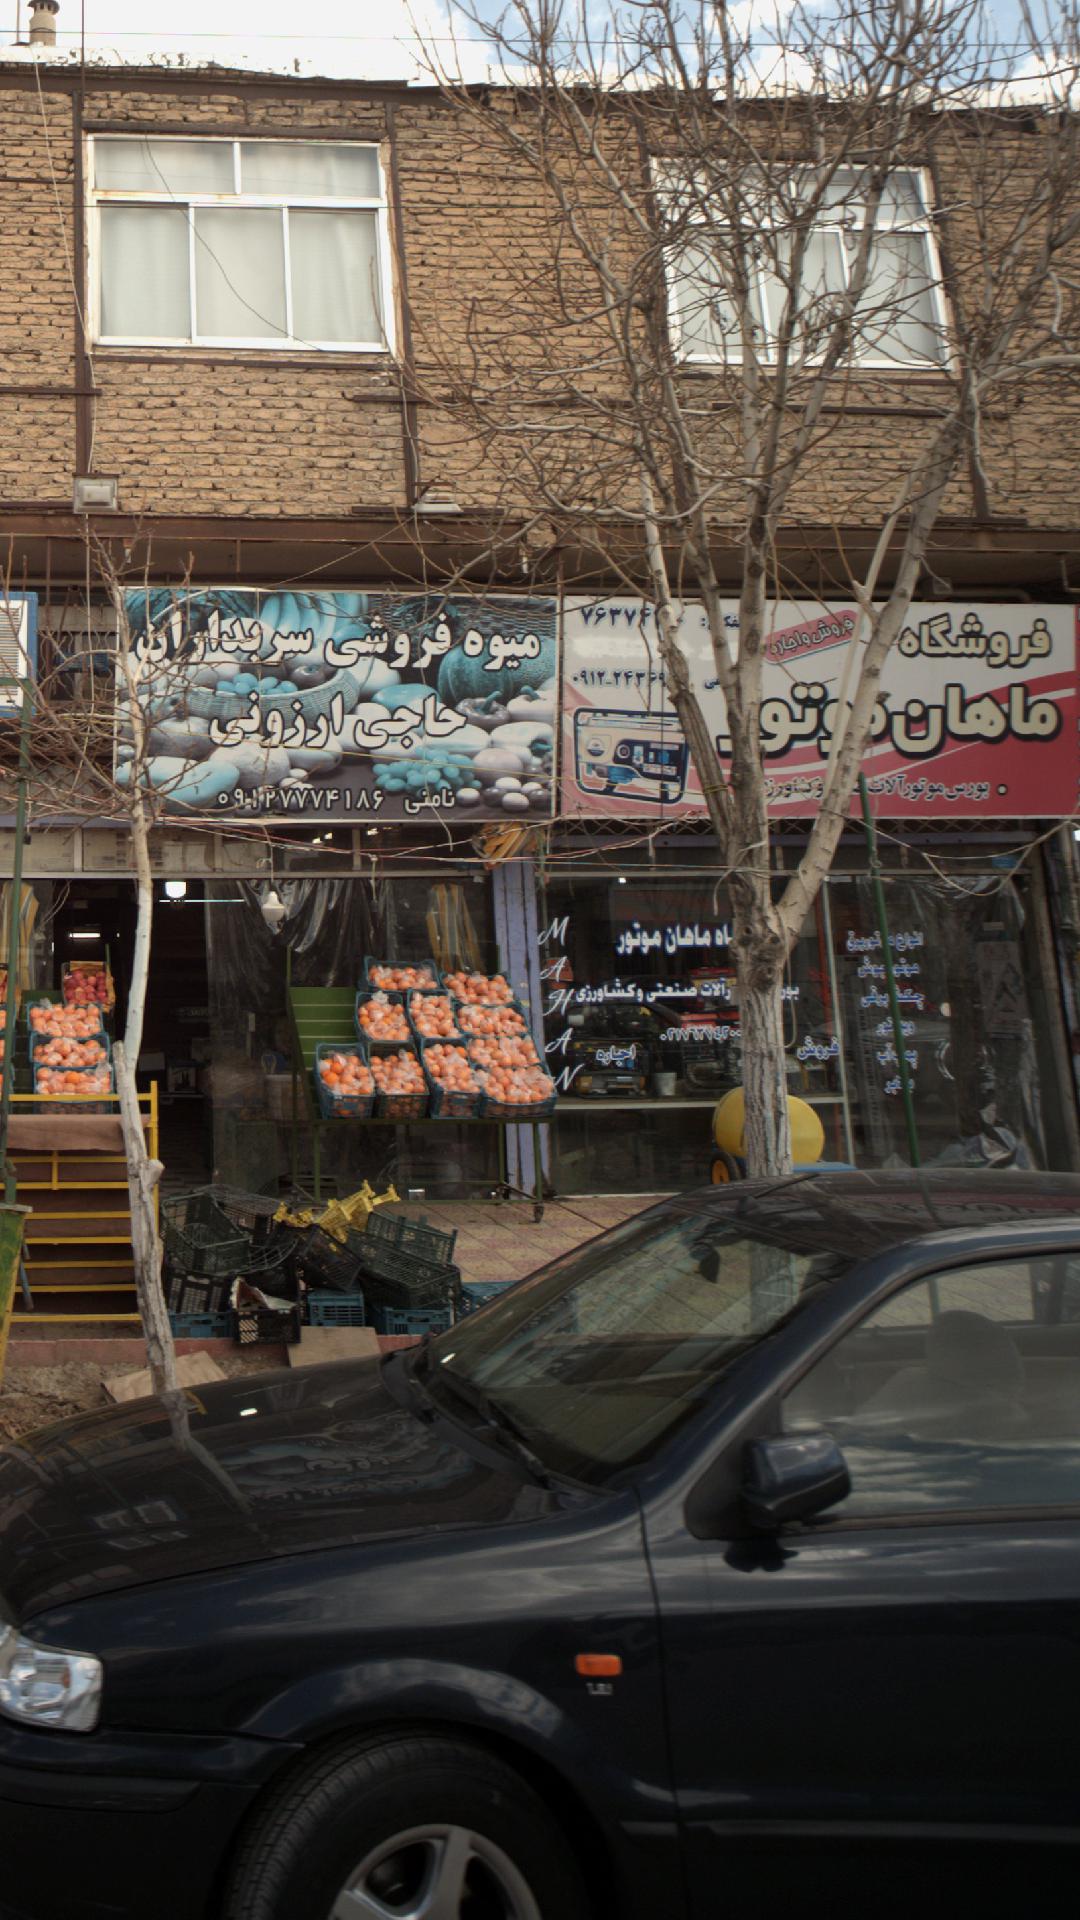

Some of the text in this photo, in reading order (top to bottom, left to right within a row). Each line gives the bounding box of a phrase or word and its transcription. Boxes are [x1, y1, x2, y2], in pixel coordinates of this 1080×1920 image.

[324, 612, 452, 668] فروشی
[463, 628, 541, 671] میوه
[898, 612, 1052, 668] فروشگاه
[208, 689, 467, 749] حاجی ارزونی
[890, 682, 1062, 760] ماهان
[616, 921, 662, 955] موتور
[665, 923, 711, 955] ماهان
[646, 982, 698, 1003] صنعتی
[595, 1044, 637, 1067] اجاره
[796, 1036, 840, 1060] فروش
